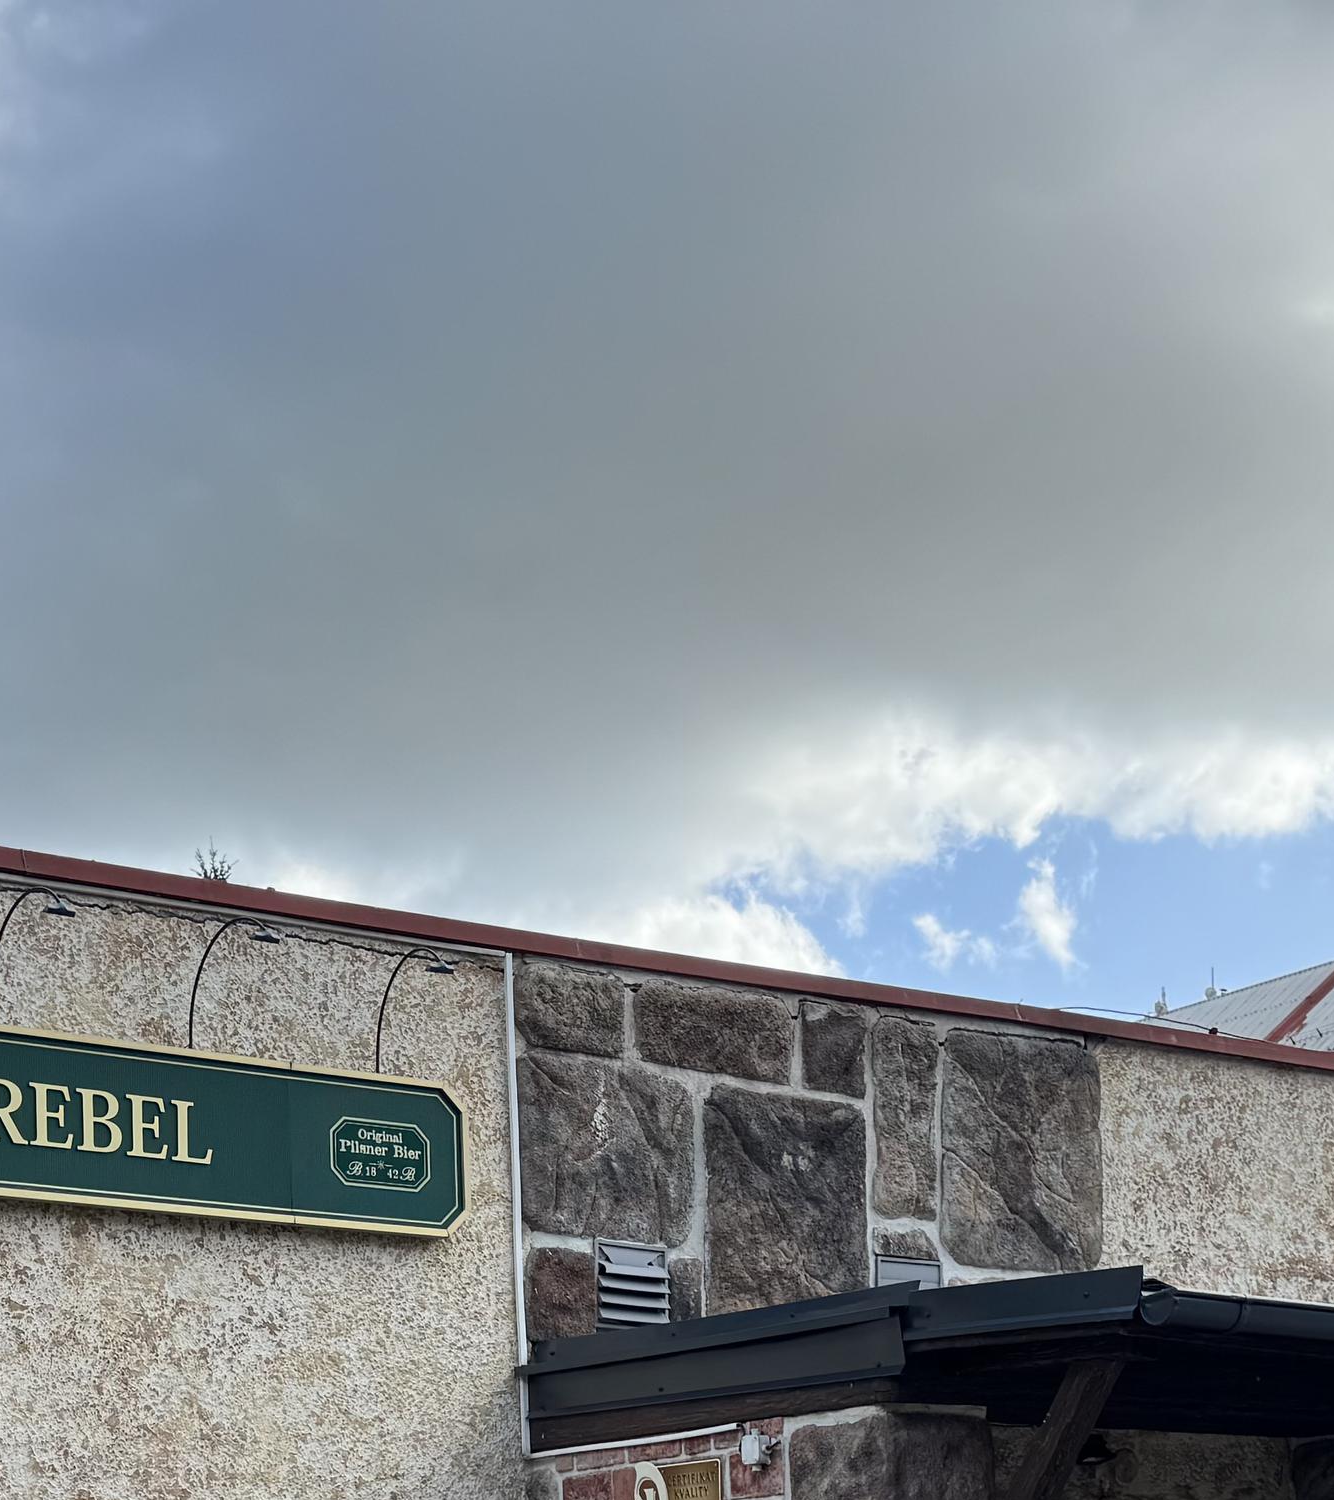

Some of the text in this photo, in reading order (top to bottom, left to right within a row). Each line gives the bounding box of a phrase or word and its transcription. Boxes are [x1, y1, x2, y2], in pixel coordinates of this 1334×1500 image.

[357, 1128, 403, 1144] Original
[339, 1139, 422, 1160] Pilsner Bier
[365, 1166, 377, 1177] 18
[387, 1168, 399, 1180] 42
